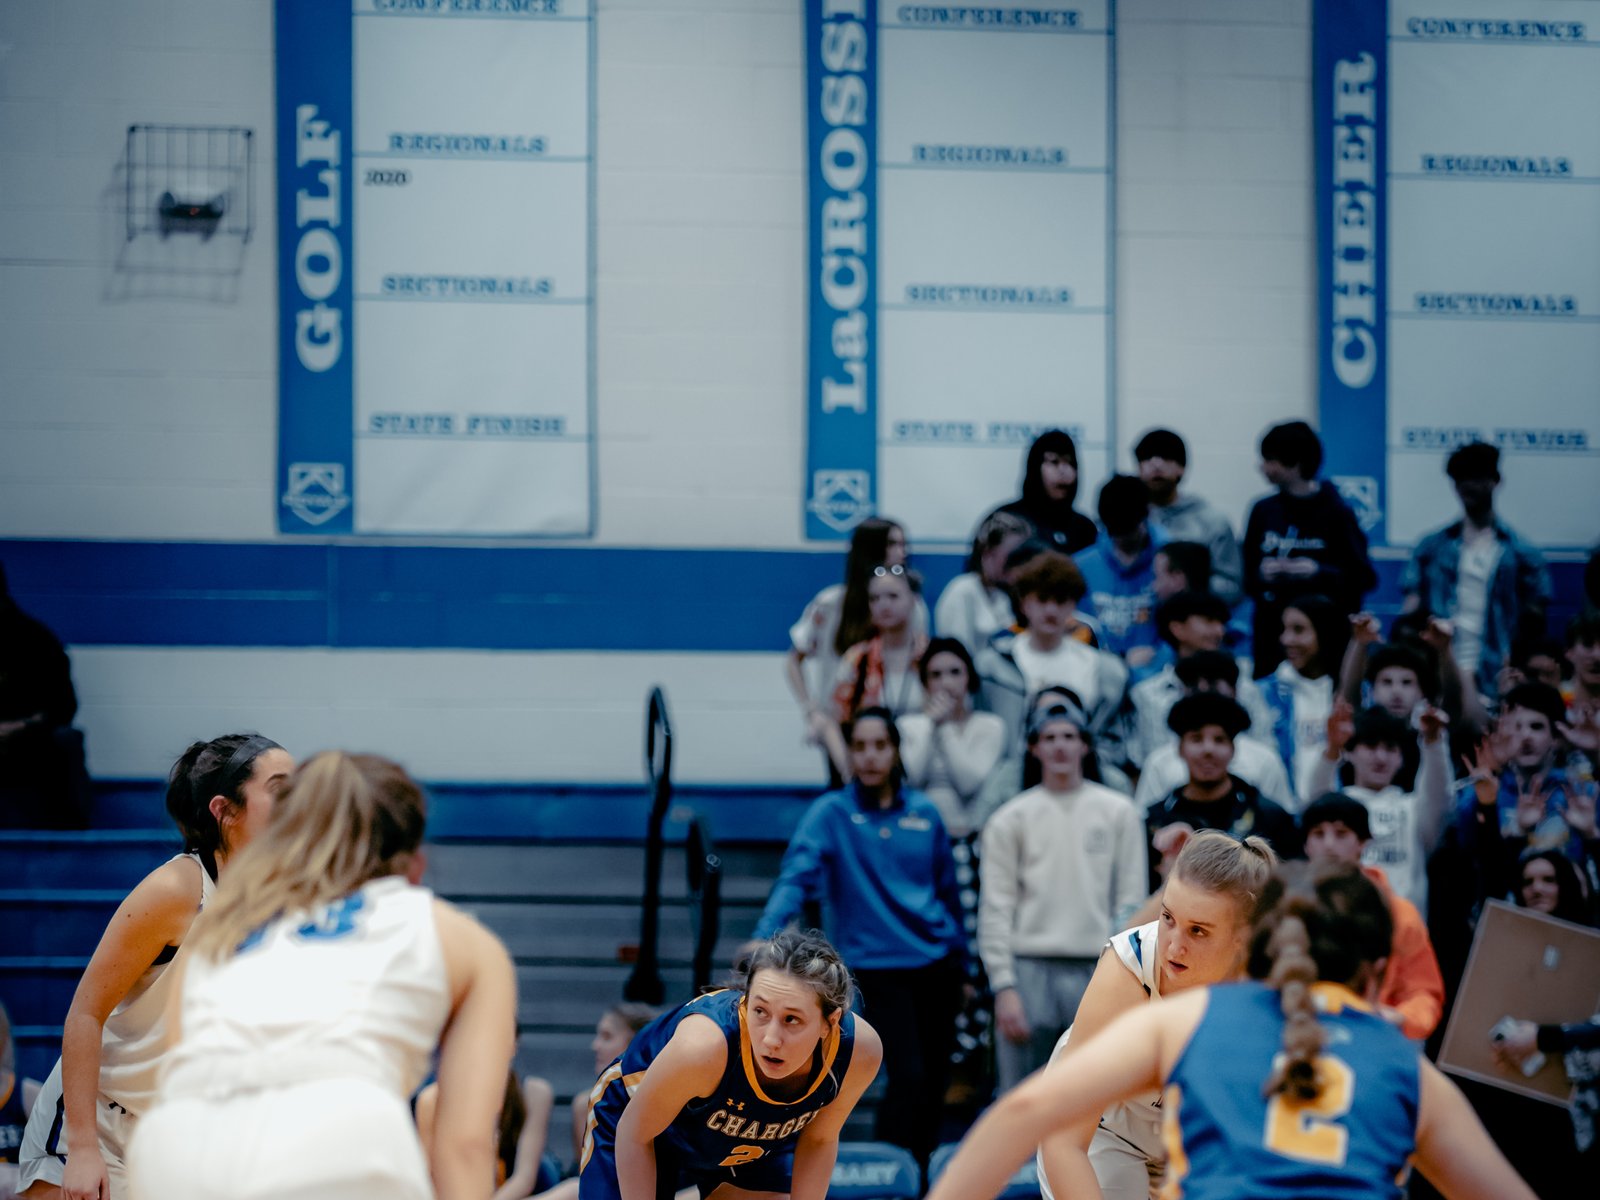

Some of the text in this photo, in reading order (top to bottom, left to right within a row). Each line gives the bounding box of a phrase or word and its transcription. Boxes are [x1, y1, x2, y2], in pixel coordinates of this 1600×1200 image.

[898, 8, 1083, 28] CONFERENCE
[1407, 17, 1586, 39] CONFERENCE
[389, 133, 548, 154] REGIONALS
[912, 144, 1068, 165] REGIONALS
[1420, 154, 1572, 176] REGIONALS
[1332, 51, 1378, 389] CHEER
[296, 104, 343, 373] GOLF
[381, 275, 554, 297] SECTIONALS
[905, 284, 1074, 305] SECTIONALS
[1415, 292, 1576, 314] SECTIONALS
[370, 412, 567, 436] STATE FINISH
[1263, 1052, 1356, 1169] 2
[718, 1144, 765, 1167] 2
